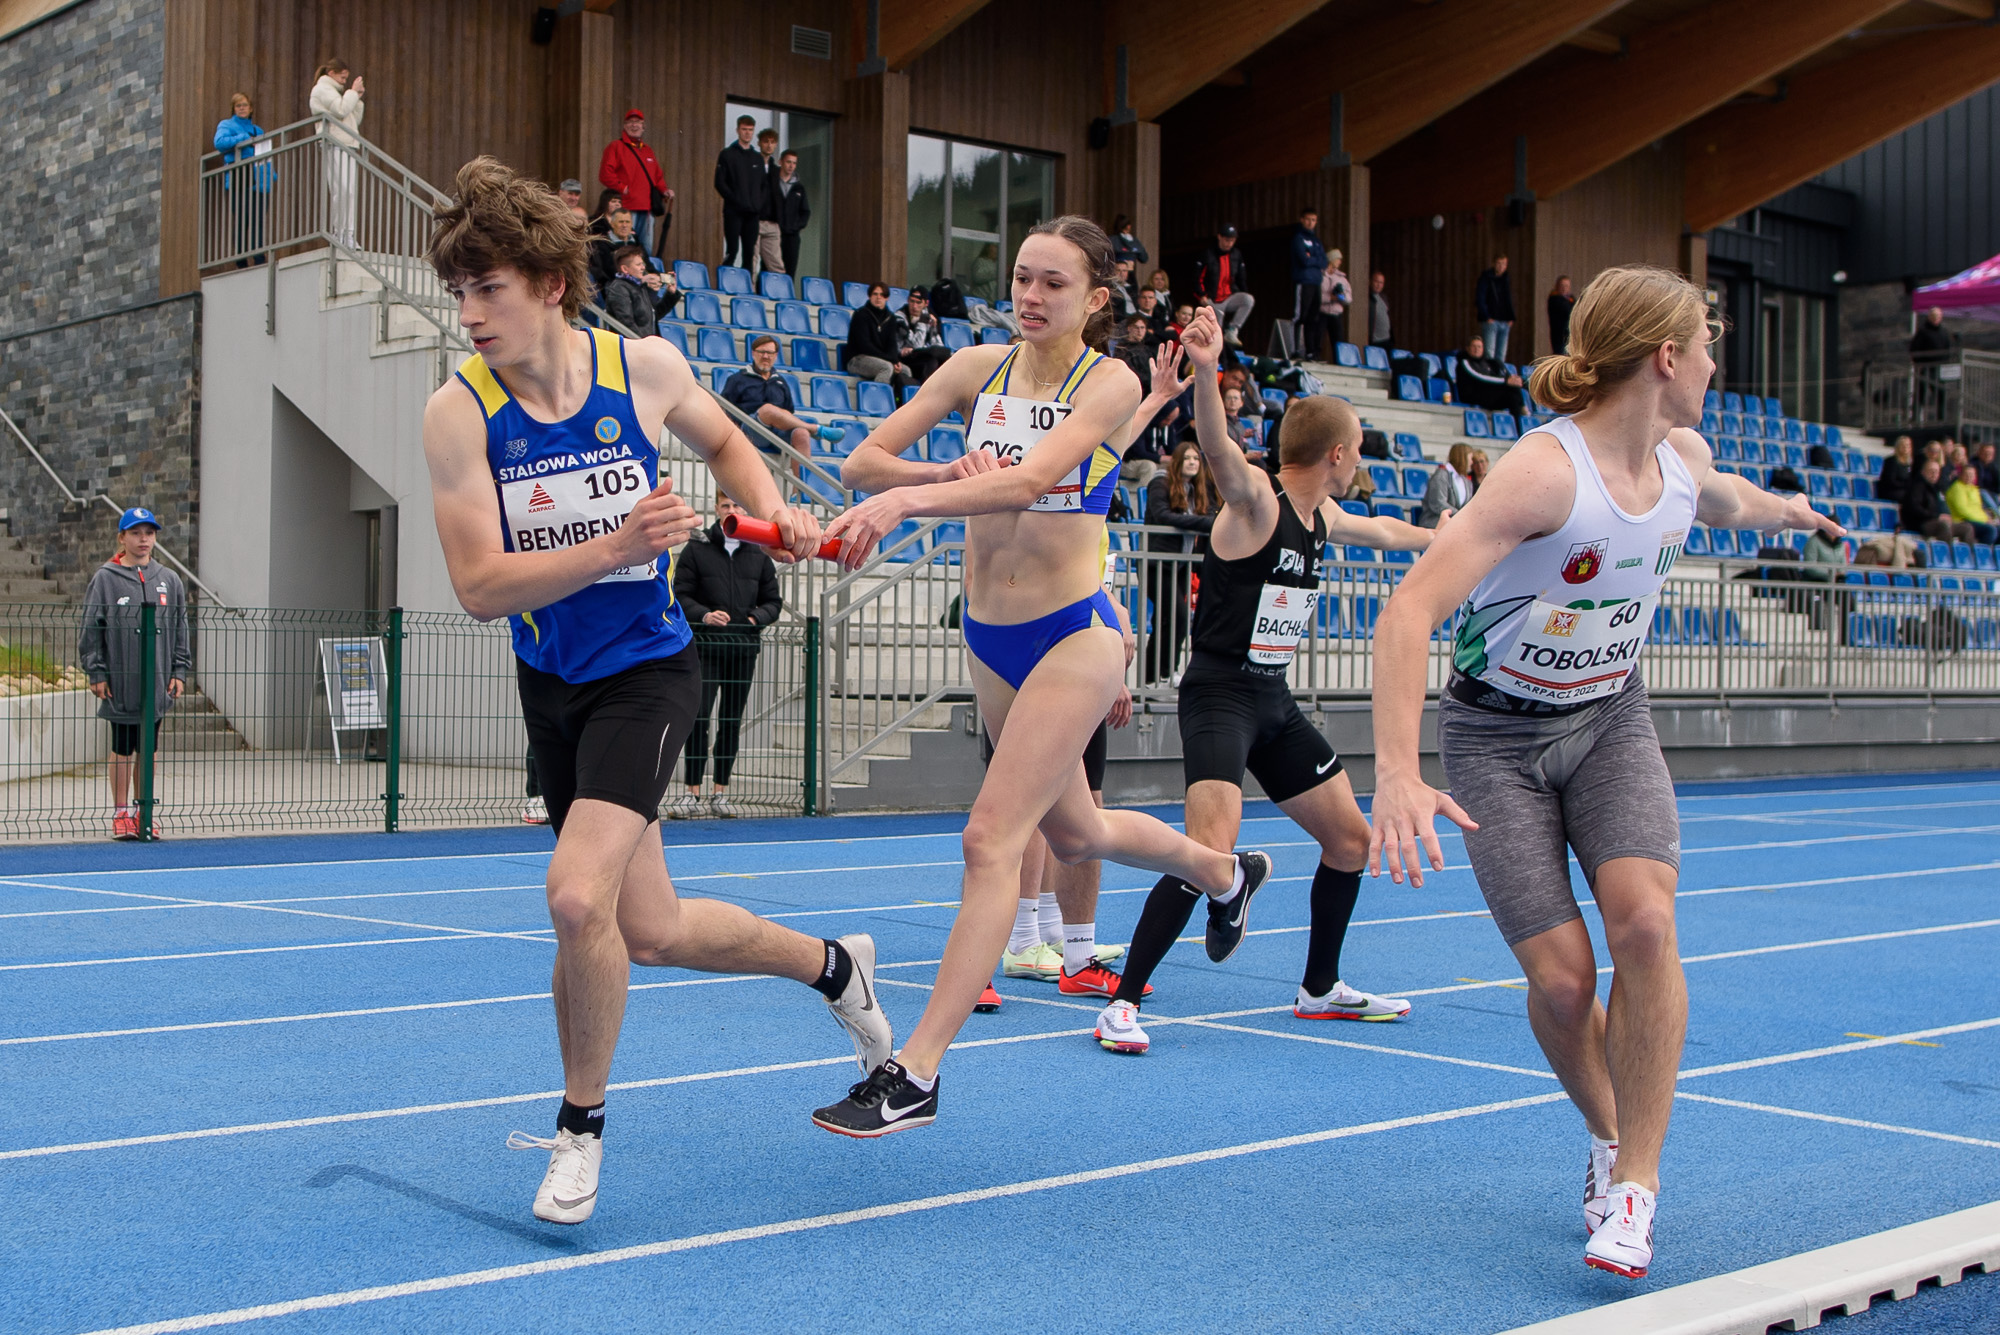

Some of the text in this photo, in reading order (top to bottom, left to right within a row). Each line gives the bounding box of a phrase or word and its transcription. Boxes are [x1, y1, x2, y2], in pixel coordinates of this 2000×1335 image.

[499, 443, 633, 481] STALOWA WOLA
[584, 465, 640, 500] 105
[528, 504, 556, 514] KARPACZ
[1608, 601, 1642, 629] 60
[1518, 637, 1641, 671] TOBOLSKI
[1514, 679, 1598, 700] KARPACZ 2022
[1476, 697, 1512, 711] adidas
[1066, 936, 1093, 944] adidas
